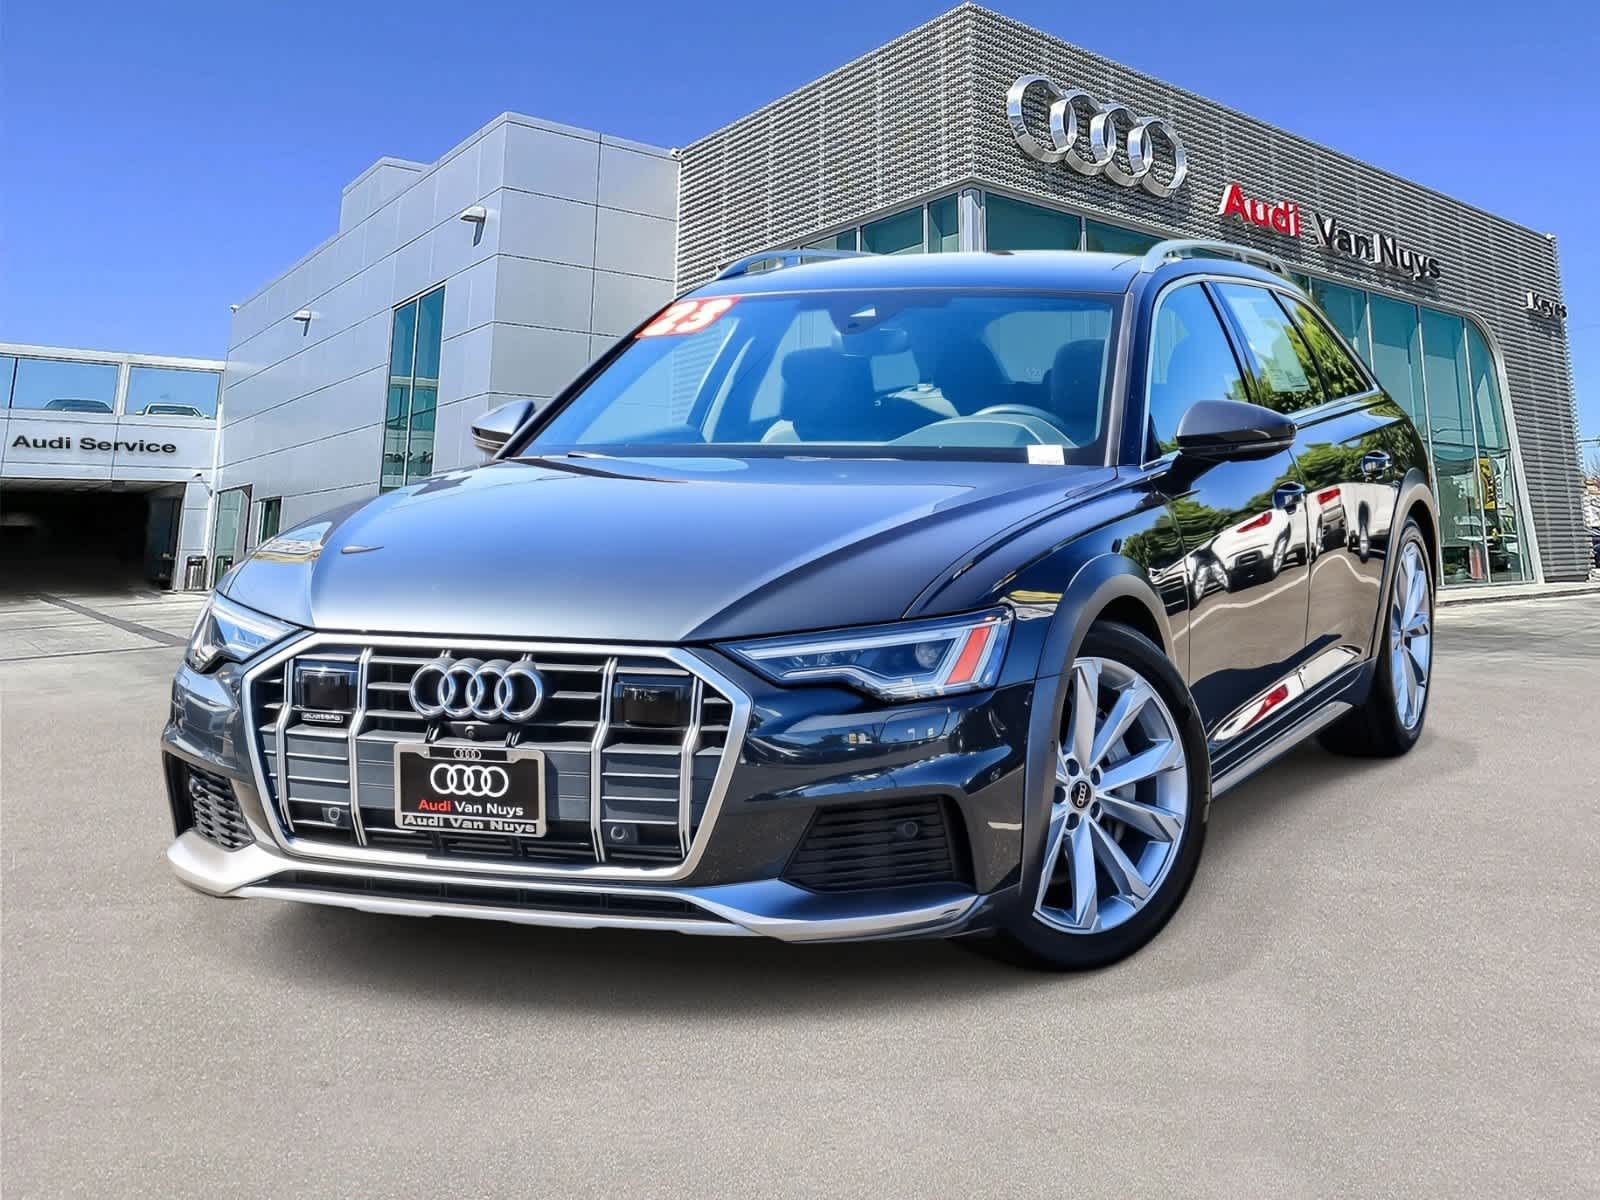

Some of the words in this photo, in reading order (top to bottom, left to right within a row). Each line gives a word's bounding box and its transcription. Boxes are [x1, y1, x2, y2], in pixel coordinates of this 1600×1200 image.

[1217, 181, 1301, 238] Audi
[1311, 213, 1371, 259] Van
[1374, 233, 1441, 281] Nuys
[12, 434, 71, 450] Audi
[79, 436, 177, 454] Service
[418, 799, 451, 812] Audi
[454, 800, 482, 814] Van
[486, 803, 524, 818] Nuys
[404, 815, 443, 827] Audi
[450, 817, 484, 830] Van
[490, 820, 536, 834] Nuys
